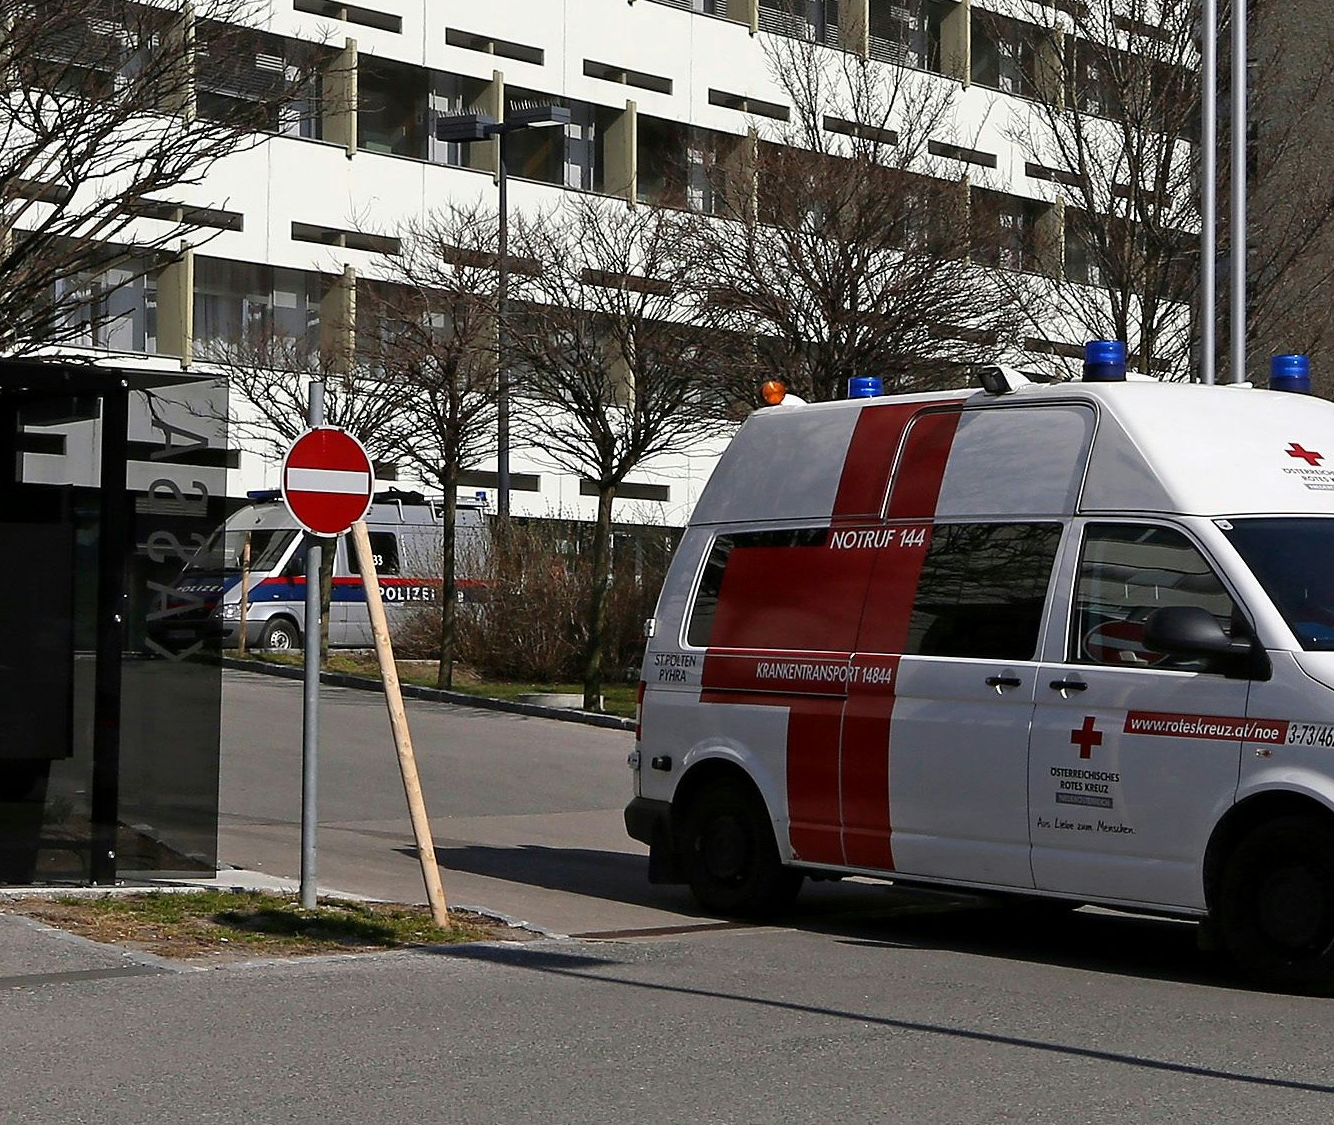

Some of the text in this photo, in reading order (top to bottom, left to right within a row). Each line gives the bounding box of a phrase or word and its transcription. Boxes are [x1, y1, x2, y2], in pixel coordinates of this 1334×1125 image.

[830, 528, 926, 549] NOTRUF 144
[378, 586, 435, 602] POLIZEI
[658, 668, 687, 683] PYHRA
[755, 661, 892, 684] KRANKENTRANSPORT 14844
[1130, 718, 1280, 741] www.roteskreuz.at/noe
[1059, 780, 1109, 794] ROTES KREUZ
[1054, 817, 1075, 830] Liebe
